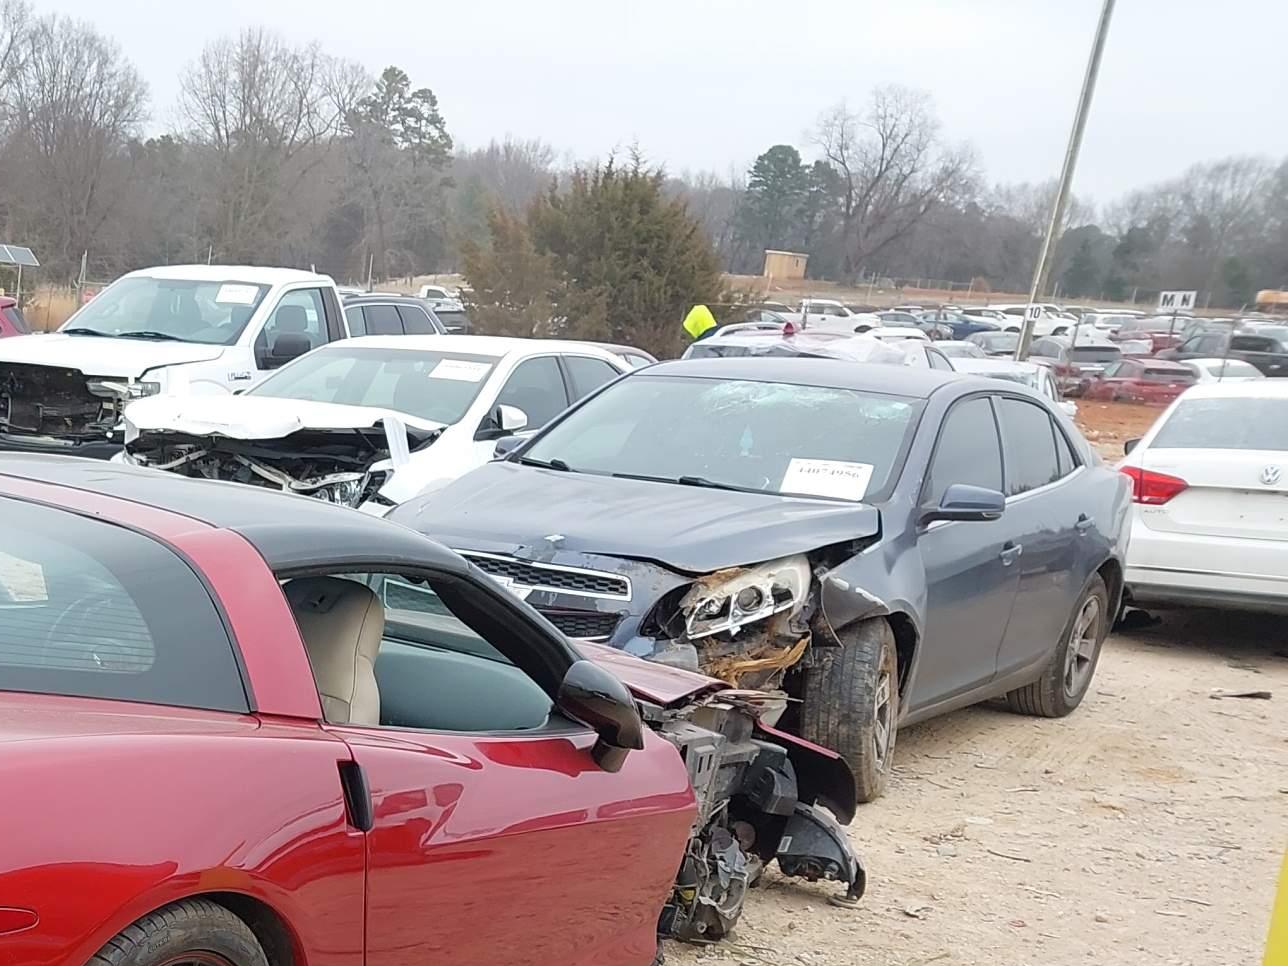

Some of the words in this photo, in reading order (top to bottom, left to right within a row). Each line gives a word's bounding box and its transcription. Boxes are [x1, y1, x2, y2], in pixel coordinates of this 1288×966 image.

[1162, 294, 1175, 306] M
[1181, 294, 1192, 306] N
[1029, 307, 1041, 318] 10
